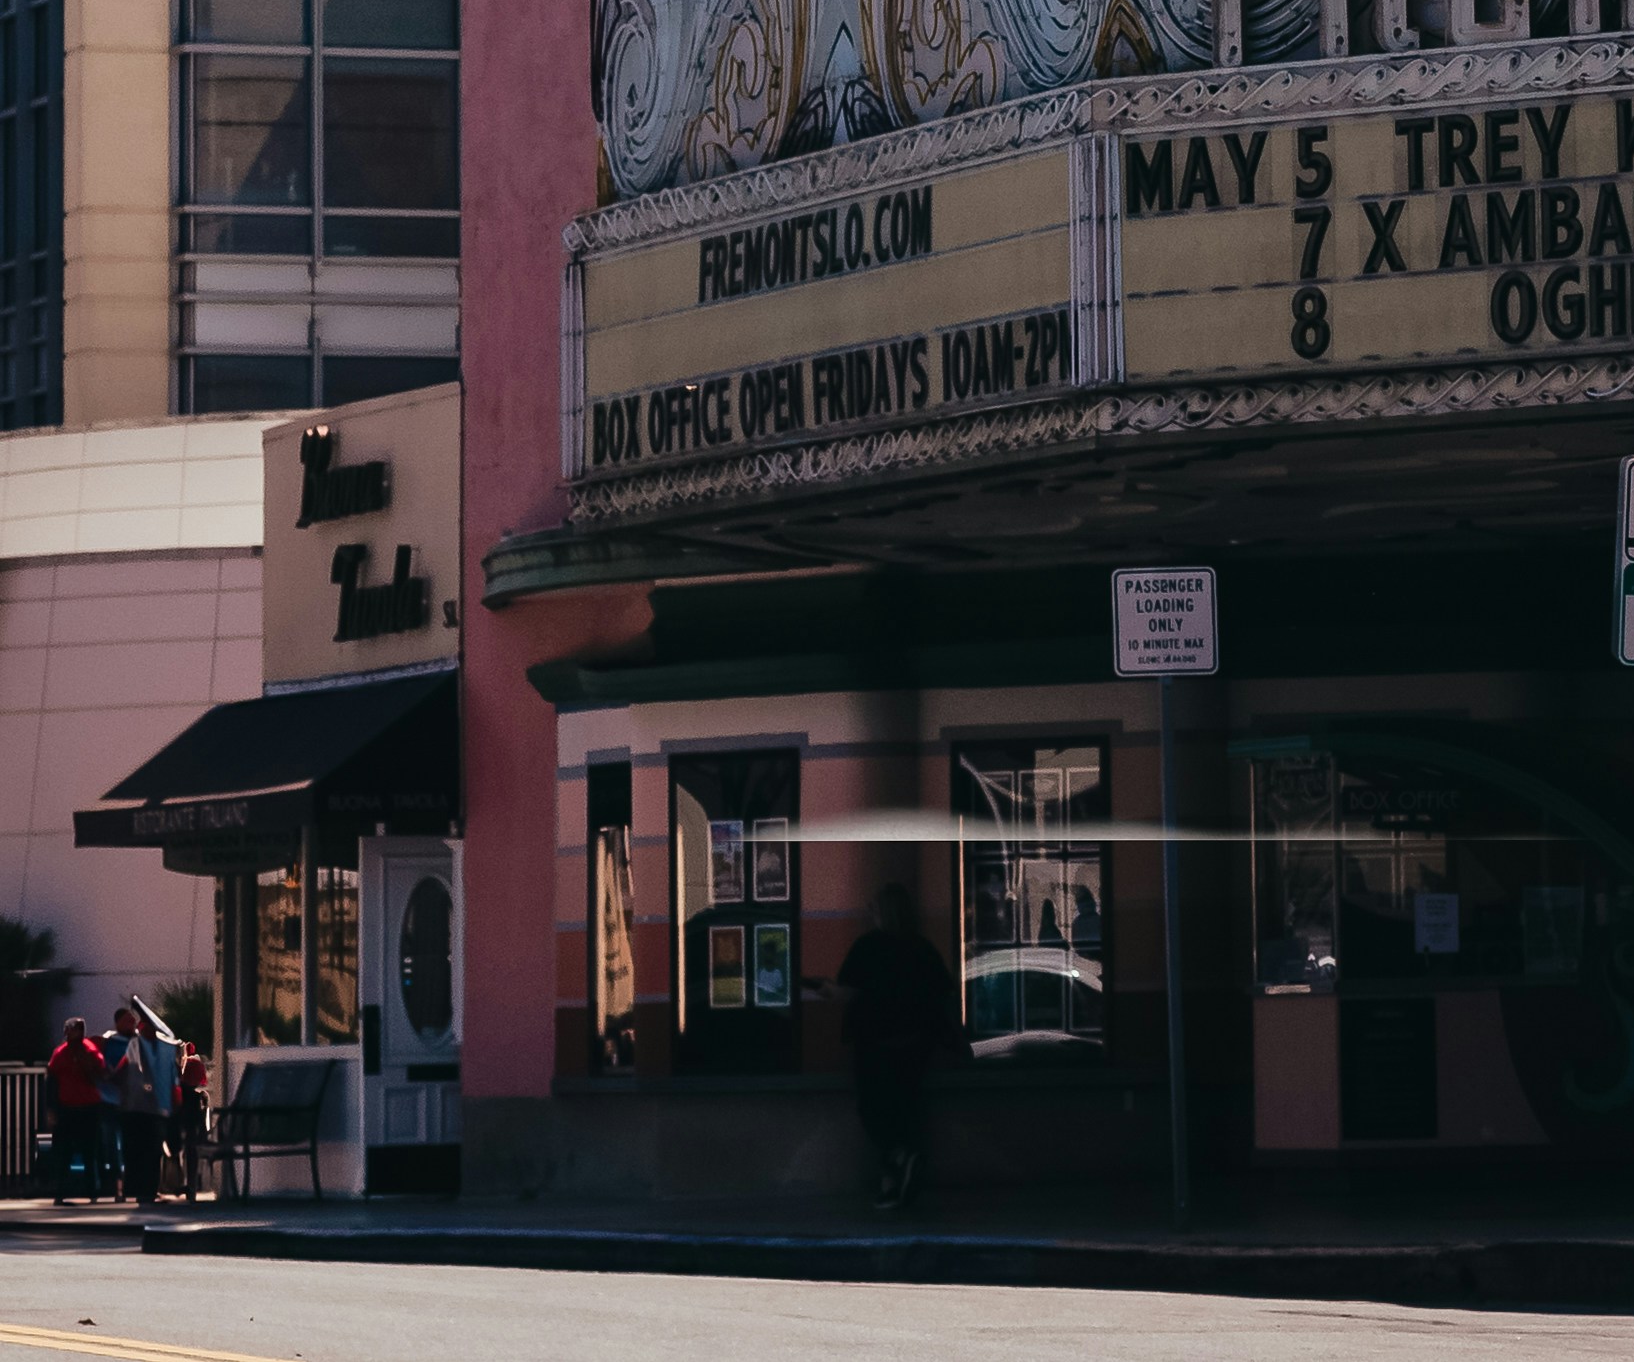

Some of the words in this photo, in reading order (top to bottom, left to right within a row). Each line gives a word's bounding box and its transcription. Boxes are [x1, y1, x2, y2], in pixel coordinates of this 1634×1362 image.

[1126, 131, 1268, 215] MAY
[1296, 125, 1333, 199] 5
[1395, 104, 1571, 191] TREY
[699, 184, 933, 305] FREMONTSLO.COM
[1294, 206, 1333, 279] 7
[1363, 199, 1408, 274] X
[1290, 286, 1331, 360] 8
[592, 394, 641, 466] BOX
[647, 377, 732, 456] OFFICE
[739, 361, 803, 438] OPEN
[811, 336, 929, 425] FRIDAYS
[1125, 579, 1203, 594] PASSENGER
[1136, 598, 1194, 613] LOADING
[1128, 639, 1139, 651] 10
[1143, 638, 1180, 649] MINUTE
[1184, 638, 1204, 649] MAX
[1148, 618, 1183, 632] ONLY
[1350, 791, 1389, 810] BOX
[1398, 790, 1458, 810] OFFICE
